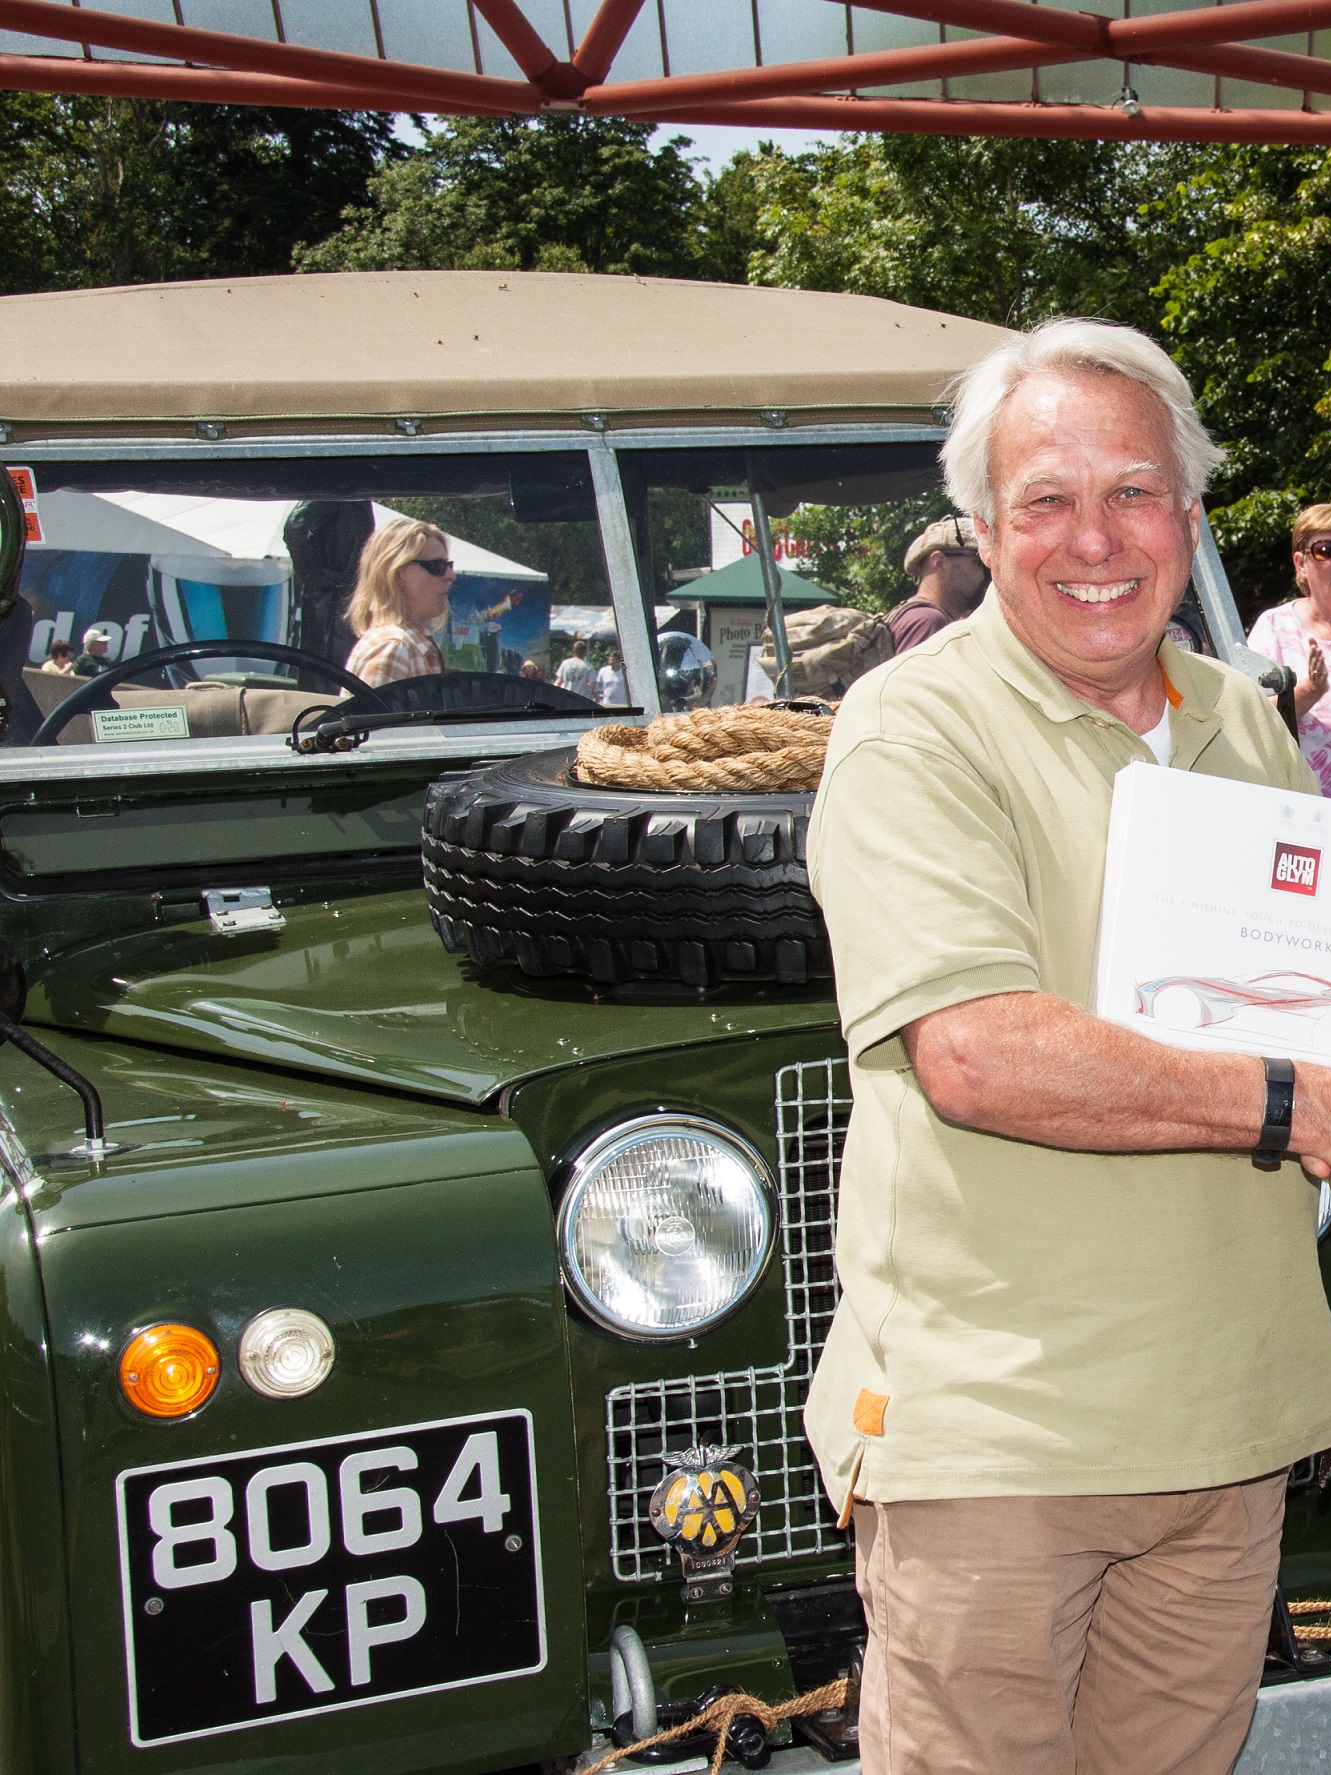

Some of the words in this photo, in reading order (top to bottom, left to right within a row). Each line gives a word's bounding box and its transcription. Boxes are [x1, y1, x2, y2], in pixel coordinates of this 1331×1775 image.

[720, 626, 750, 644] Photo
[101, 714, 138, 722] Database
[140, 712, 178, 720] Protected
[1278, 852, 1316, 872] AUTO
[1276, 866, 1314, 886] GLYM
[1154, 895, 1175, 905] THE
[1181, 899, 1239, 917] FINISHING
[1244, 911, 1283, 925] TOUCH
[1288, 919, 1303, 929] TO
[148, 1430, 512, 1590] 8064
[250, 1574, 428, 1705] KP
